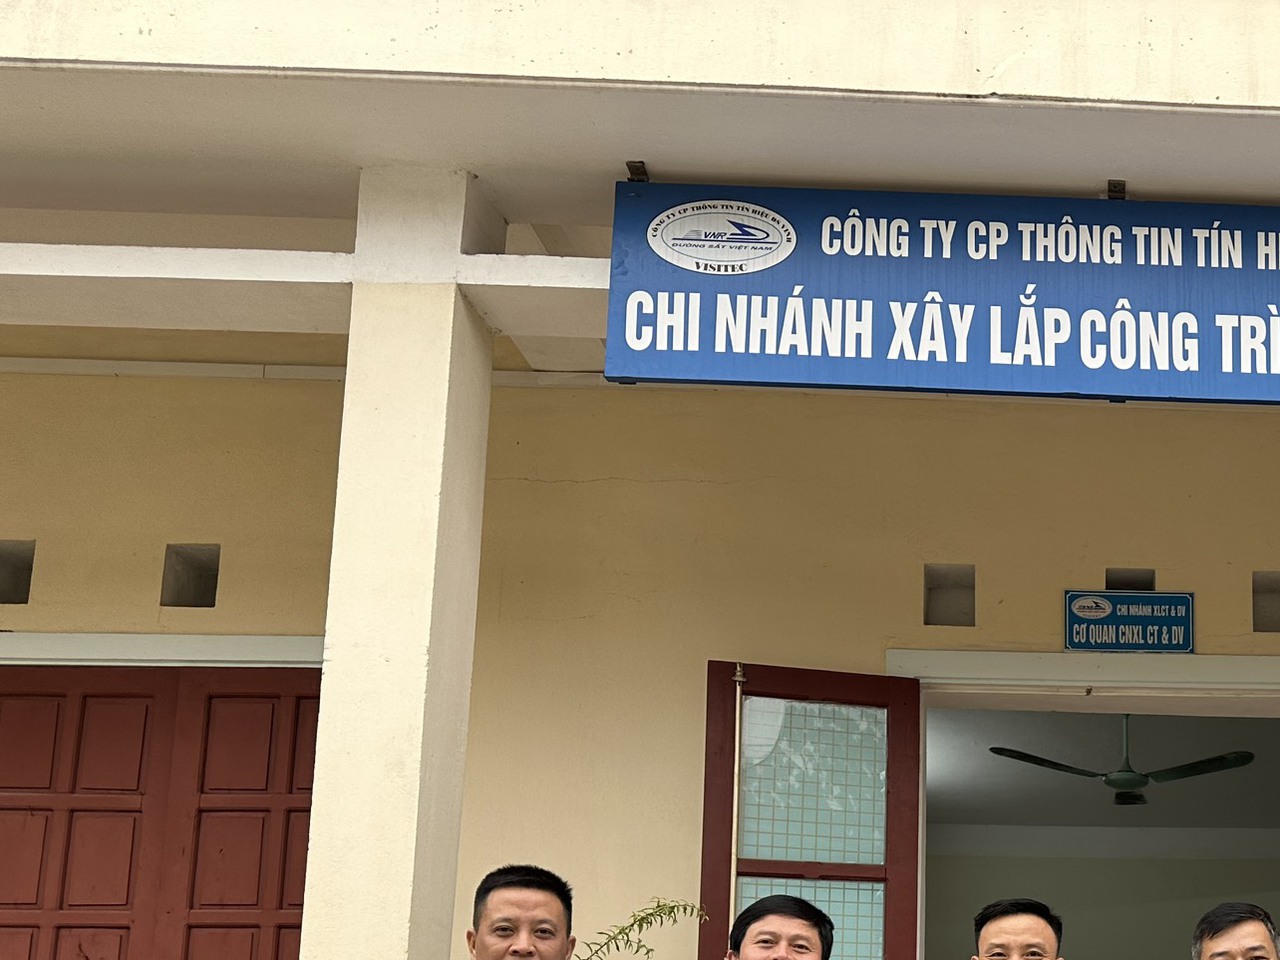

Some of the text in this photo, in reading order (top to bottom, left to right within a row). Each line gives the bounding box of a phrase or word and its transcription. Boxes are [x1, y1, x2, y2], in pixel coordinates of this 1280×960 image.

[691, 203, 718, 212] THÔNG
[704, 231, 727, 240] VNR
[821, 209, 910, 258] CÔNG
[920, 220, 957, 259] TY
[968, 221, 1009, 261] CP
[1018, 216, 1123, 265] THÔNG
[1132, 227, 1183, 267] TIN
[1193, 221, 1243, 269] TÍN
[695, 261, 748, 272] VISITEC
[626, 291, 701, 352] CHI
[715, 285, 874, 359] NHÁNH
[887, 291, 976, 363] XÂY
[990, 284, 1072, 367] LẮP
[1080, 298, 1200, 372] CÔNG
[1117, 602, 1186, 617] CHI NHÁNH XLCT & DV
[1073, 623, 1184, 645] CƠ QUAN CNXL CT & DV
